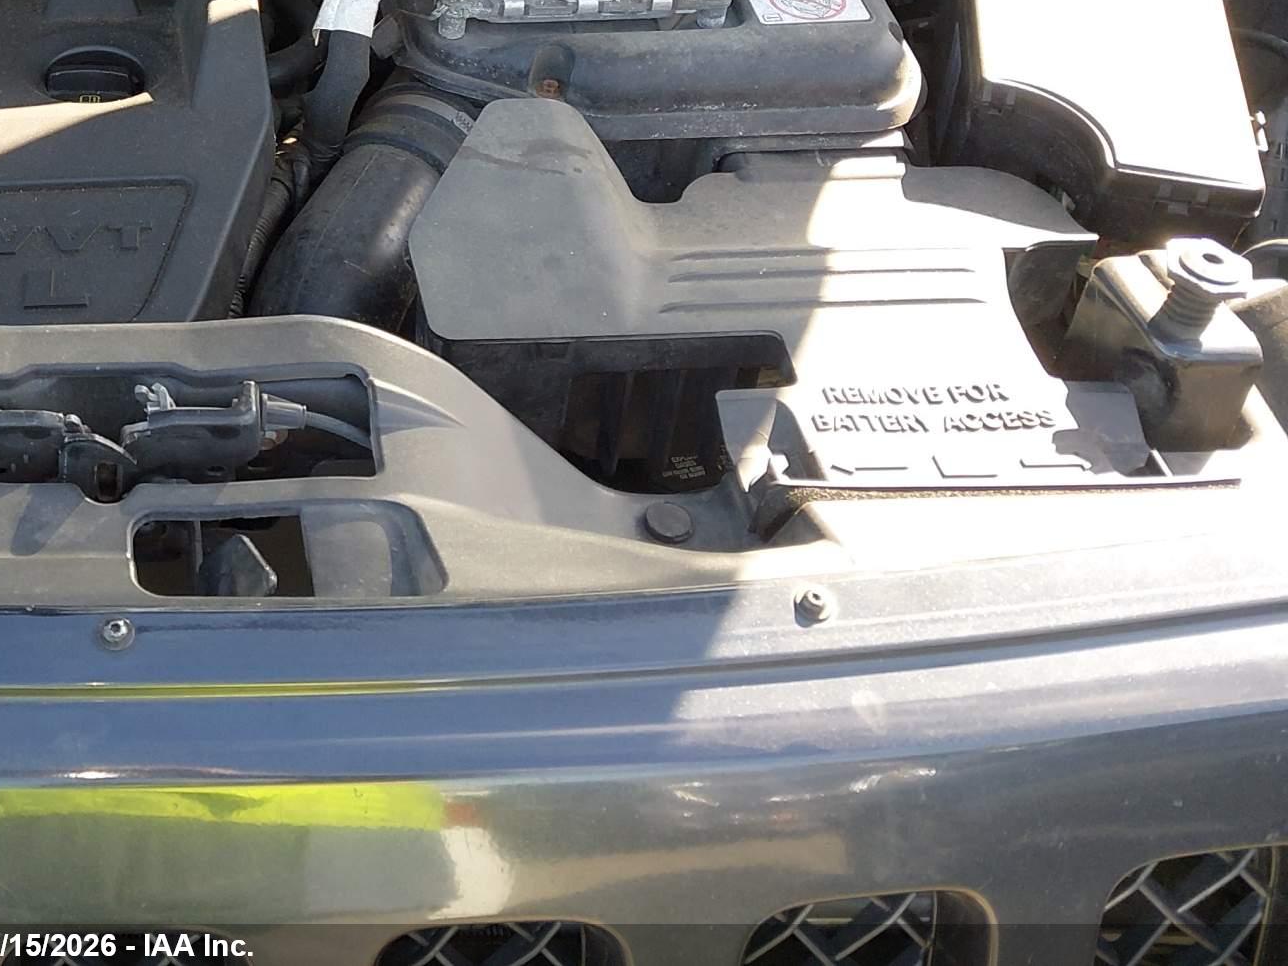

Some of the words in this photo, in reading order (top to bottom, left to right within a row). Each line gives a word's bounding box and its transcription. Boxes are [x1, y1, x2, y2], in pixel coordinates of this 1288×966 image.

[821, 385, 943, 405] REMOVE
[946, 382, 1010, 404] FOR
[810, 412, 930, 433] BATTERY
[943, 410, 1057, 432] ACCESS
